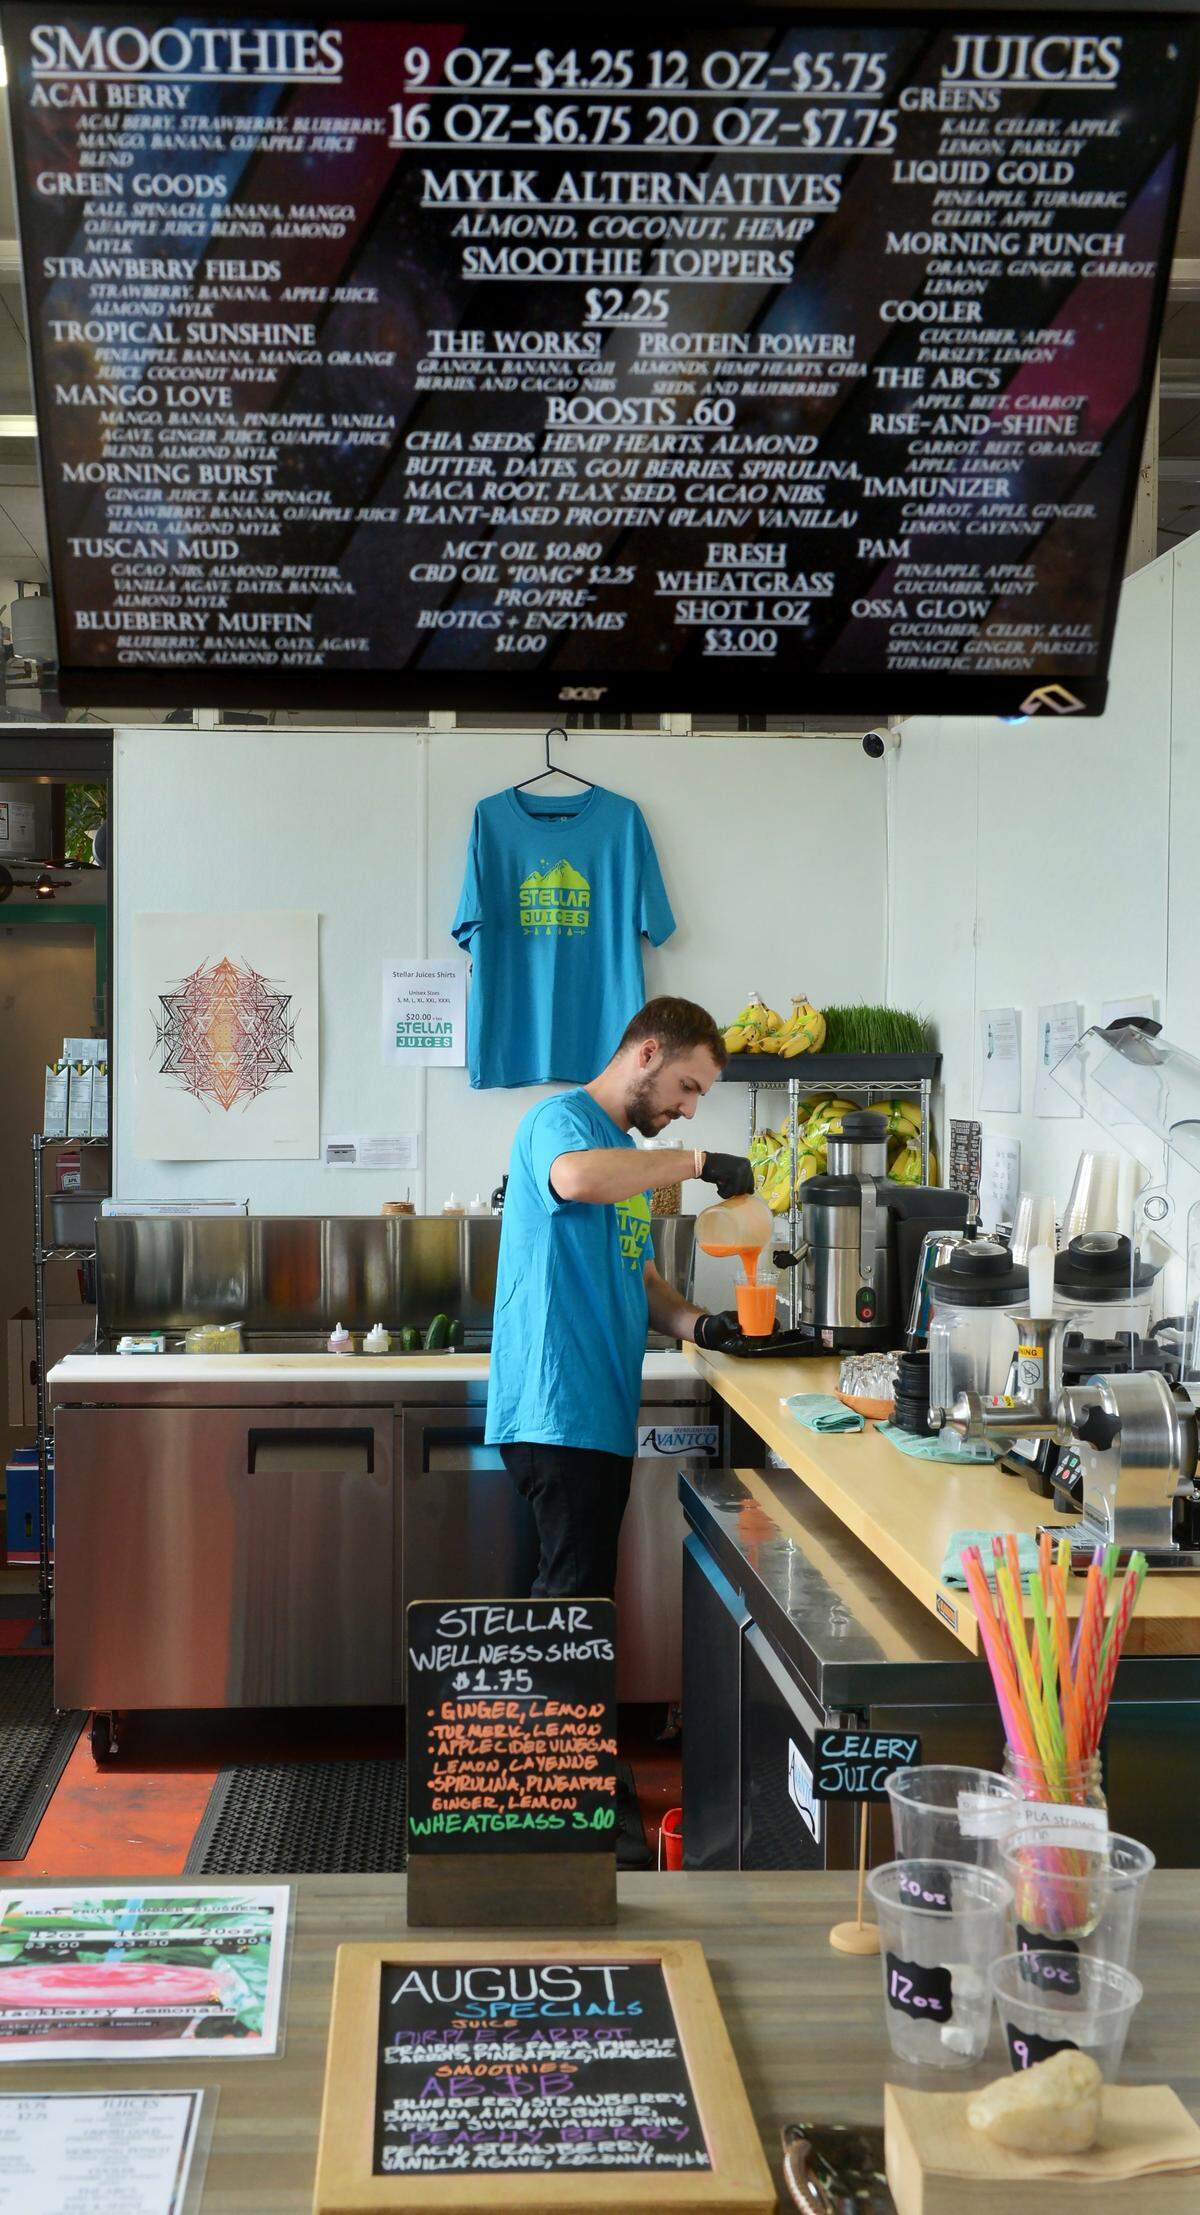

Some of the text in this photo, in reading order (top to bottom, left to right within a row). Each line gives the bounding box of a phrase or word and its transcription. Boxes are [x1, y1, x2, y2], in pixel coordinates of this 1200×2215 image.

[29, 25, 343, 73] SMOOTHIES
[941, 35, 1123, 81] JUICES
[404, 46, 888, 92] 9 OZ-$4.25 12 OZ-$5.75
[107, 85, 191, 109] BERRY
[899, 87, 1001, 112] GREENS
[388, 102, 899, 147] 16 OZ-$6.75 20 OZ-$7.75
[1010, 139, 1086, 156] PARSLEY
[892, 160, 1075, 185] LIQUID GOLD
[36, 172, 227, 198] GREEN GOODS
[421, 169, 842, 206] MYLK ALTERNATIVES
[271, 223, 346, 238] ALMOND
[735, 217, 815, 241] HEMP
[885, 231, 1126, 256] MORNING PUNCH
[43, 256, 282, 281] STRAWBERRY FIELDS
[462, 246, 794, 277] SMOOTHIE TOPPERS
[923, 279, 989, 295] LEMON
[90, 301, 215, 318] ALMOND MYLK
[585, 287, 670, 321] $2.25
[879, 300, 984, 323] COOLER
[49, 320, 317, 346] TROPICAL SUNSHINE
[426, 330, 601, 354] THE WORKS!
[638, 332, 855, 355] PROTEIN POWER!
[147, 367, 279, 383] COCONUT MYLK
[480, 377, 618, 392] AND CACAO NIBS
[872, 366, 1002, 389] THE ABC'S
[55, 384, 232, 407] MANGO LOVE
[548, 396, 676, 426] BOOSTS
[868, 413, 1079, 437] RISE-AND-SHINE
[159, 445, 280, 461] ALMOND MYLK
[405, 431, 463, 451] CHIA
[542, 433, 612, 453] HEMP
[712, 434, 818, 454] ALMOND
[61, 463, 278, 486] MORNING BURST
[585, 458, 641, 478] GOJI
[404, 480, 768, 503] MACA FLAX CACAO
[863, 477, 1010, 498] IMMUNIZER
[405, 505, 560, 525] PLANT-BASED
[564, 507, 664, 527] PROTEIN
[757, 509, 858, 529] VANILLA)
[966, 521, 1045, 536] CAYENNE
[68, 537, 240, 560] TUSCAN MUD
[441, 541, 603, 561] MCT OIL $0.80
[706, 543, 788, 563] FRESH
[857, 538, 911, 559] PAM
[111, 563, 278, 579] CACAO ALMOND
[409, 564, 636, 584] CBD OIL $2.25
[657, 571, 835, 592] WHEATGRASS
[494, 588, 597, 608] PRO/PRE-
[990, 581, 1038, 595] MINT
[417, 610, 627, 630] BIOTICS ENZYMES
[675, 600, 811, 621] SHOT OZ
[851, 600, 991, 619] OSSA GLOW
[75, 611, 313, 633] BLUEBERRY MUFFIN
[494, 634, 547, 653] $1.00
[705, 629, 778, 651] $3.00
[210, 651, 326, 666] ALMOND MYLK
[975, 657, 1035, 670] LEMON
[519, 889, 590, 907] STELLAR
[524, 911, 586, 925] JUICES
[406, 1013, 432, 1021] $20.00
[396, 1022, 453, 1034] STELLAR
[399, 1037, 451, 1047] JUICES
[436, 1607, 592, 1638] STELLAR
[409, 1639, 615, 1671] WELLNESS SHOTS
[452, 1668, 533, 1692] $1.75
[529, 1702, 605, 1719] LEMON
[533, 1723, 602, 1737] LEMON
[438, 1740, 493, 1756] APPLE
[495, 1740, 548, 1754] CIDER
[822, 1735, 918, 1763] CELERY
[509, 1755, 598, 1772] CAYENNE
[819, 1763, 912, 1792] JUICE
[508, 1796, 576, 1810] LEMON
[409, 1807, 615, 1836] WHEATGRASS 3.00
[1025, 1808, 1049, 1822] PLA
[24, 1940, 80, 1950] $3.00
[203, 1937, 258, 1946] $4.00
[33, 1929, 86, 1939] 12oz
[200, 1928, 254, 1936] 20oz
[391, 1966, 630, 2004] AUGUST
[0, 2005, 237, 2017] lackberry Lemonade
[455, 2000, 643, 2018] SPECIALS
[451, 2018, 520, 2029] JUICE
[394, 2027, 632, 2046] PURPLE CARROT
[436, 2063, 578, 2077] SMOOTHIES
[410, 2126, 689, 2146] PEACHY BERRY
